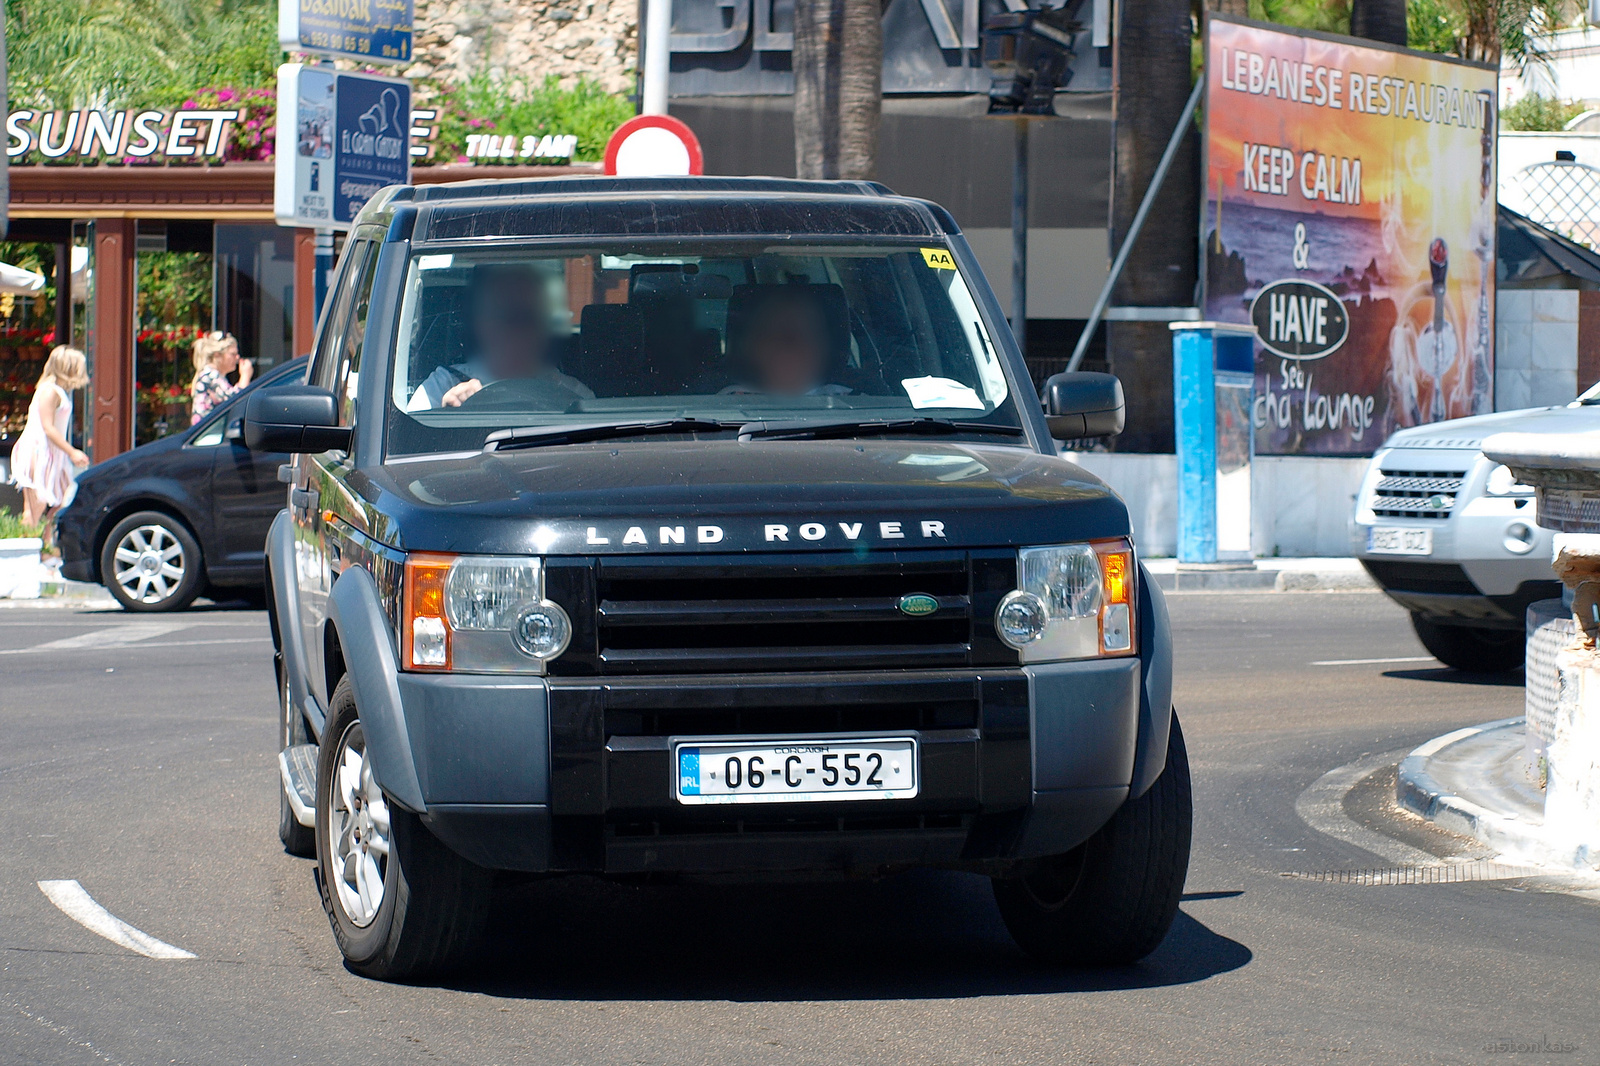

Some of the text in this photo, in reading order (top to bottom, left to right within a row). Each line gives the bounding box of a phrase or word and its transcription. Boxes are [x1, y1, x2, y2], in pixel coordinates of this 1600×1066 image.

[1221, 47, 1490, 130] LEBANESE RESTAURANT
[6, 109, 240, 157] SUNSET
[465, 133, 516, 158] TILL
[1243, 142, 1362, 206] KEEP CALM
[930, 253, 950, 265] AA
[1292, 222, 1309, 270] &
[1269, 292, 1329, 345] HAVE
[1280, 358, 1305, 391] Sea
[1303, 372, 1375, 442] Lounge
[586, 519, 947, 546] LAND ROVER
[681, 752, 884, 788] IRL 06-C-552
[773, 746, 830, 755] CORCAIGH
